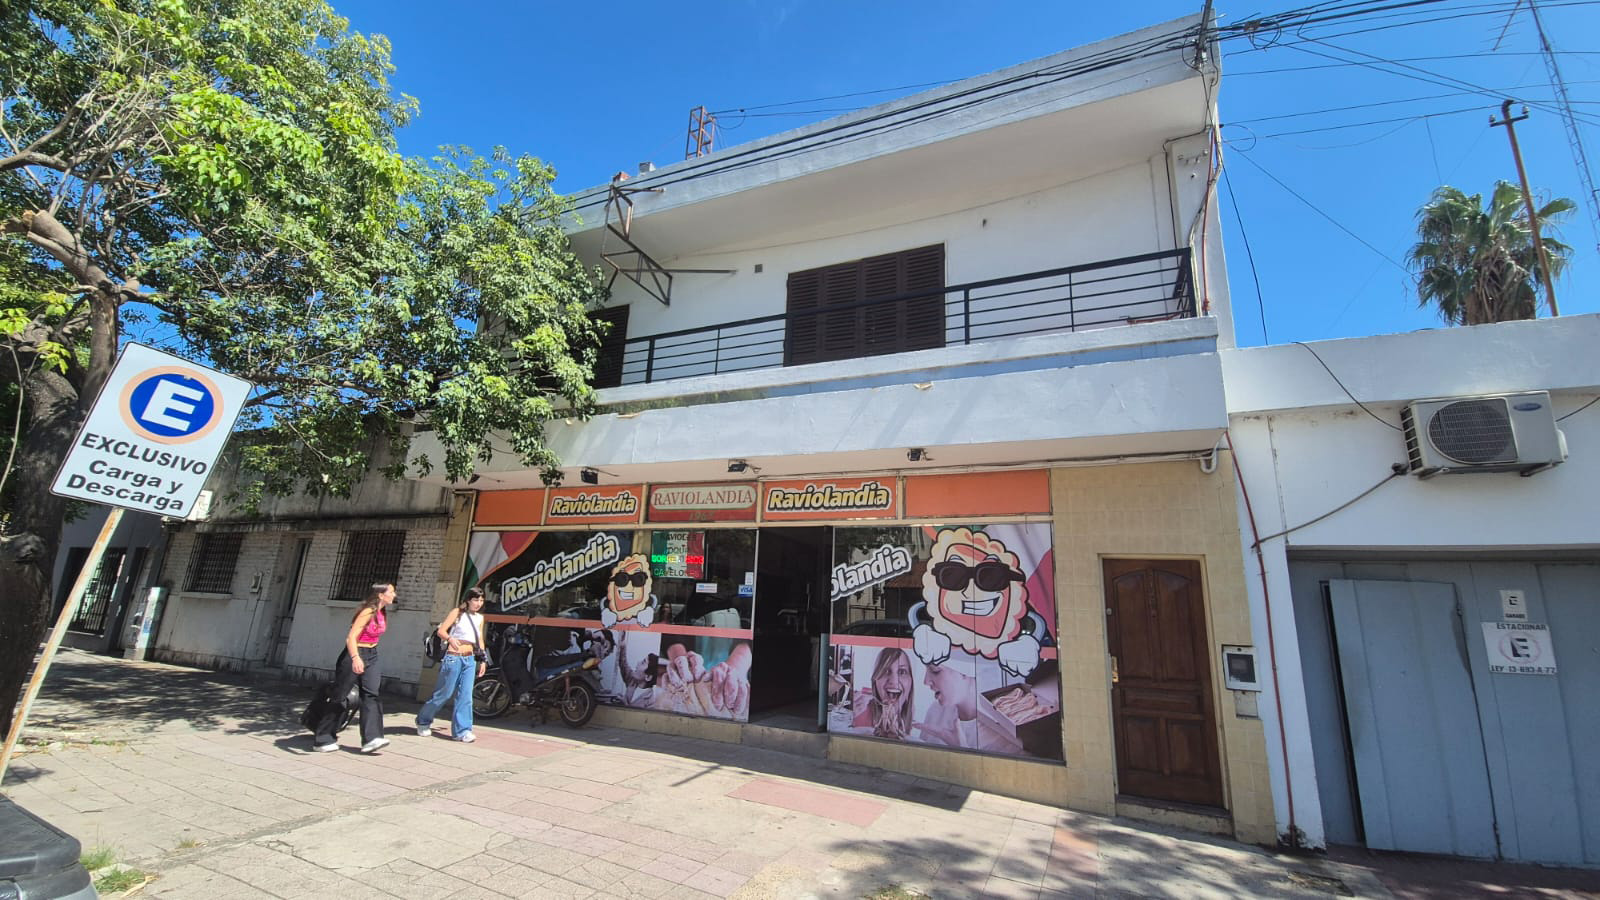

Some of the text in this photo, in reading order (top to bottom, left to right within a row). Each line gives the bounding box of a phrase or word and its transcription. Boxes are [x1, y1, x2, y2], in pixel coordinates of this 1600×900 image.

[141, 379, 204, 432] E
[80, 432, 207, 476] EXCLUSIVO
[88, 459, 184, 495] Carga y
[66, 473, 184, 511] Descarga
[550, 491, 637, 517] Raviolandia
[653, 489, 754, 506] RAVIOLANDIA
[768, 482, 889, 511] Raviolandia
[503, 532, 618, 608] Raviolandia
[740, 585, 753, 593] VISA
[1508, 595, 1519, 606] E
[1496, 622, 1547, 631] ESTACIONAR
[1510, 637, 1530, 658] E
[1490, 664, 1505, 672] LEY
